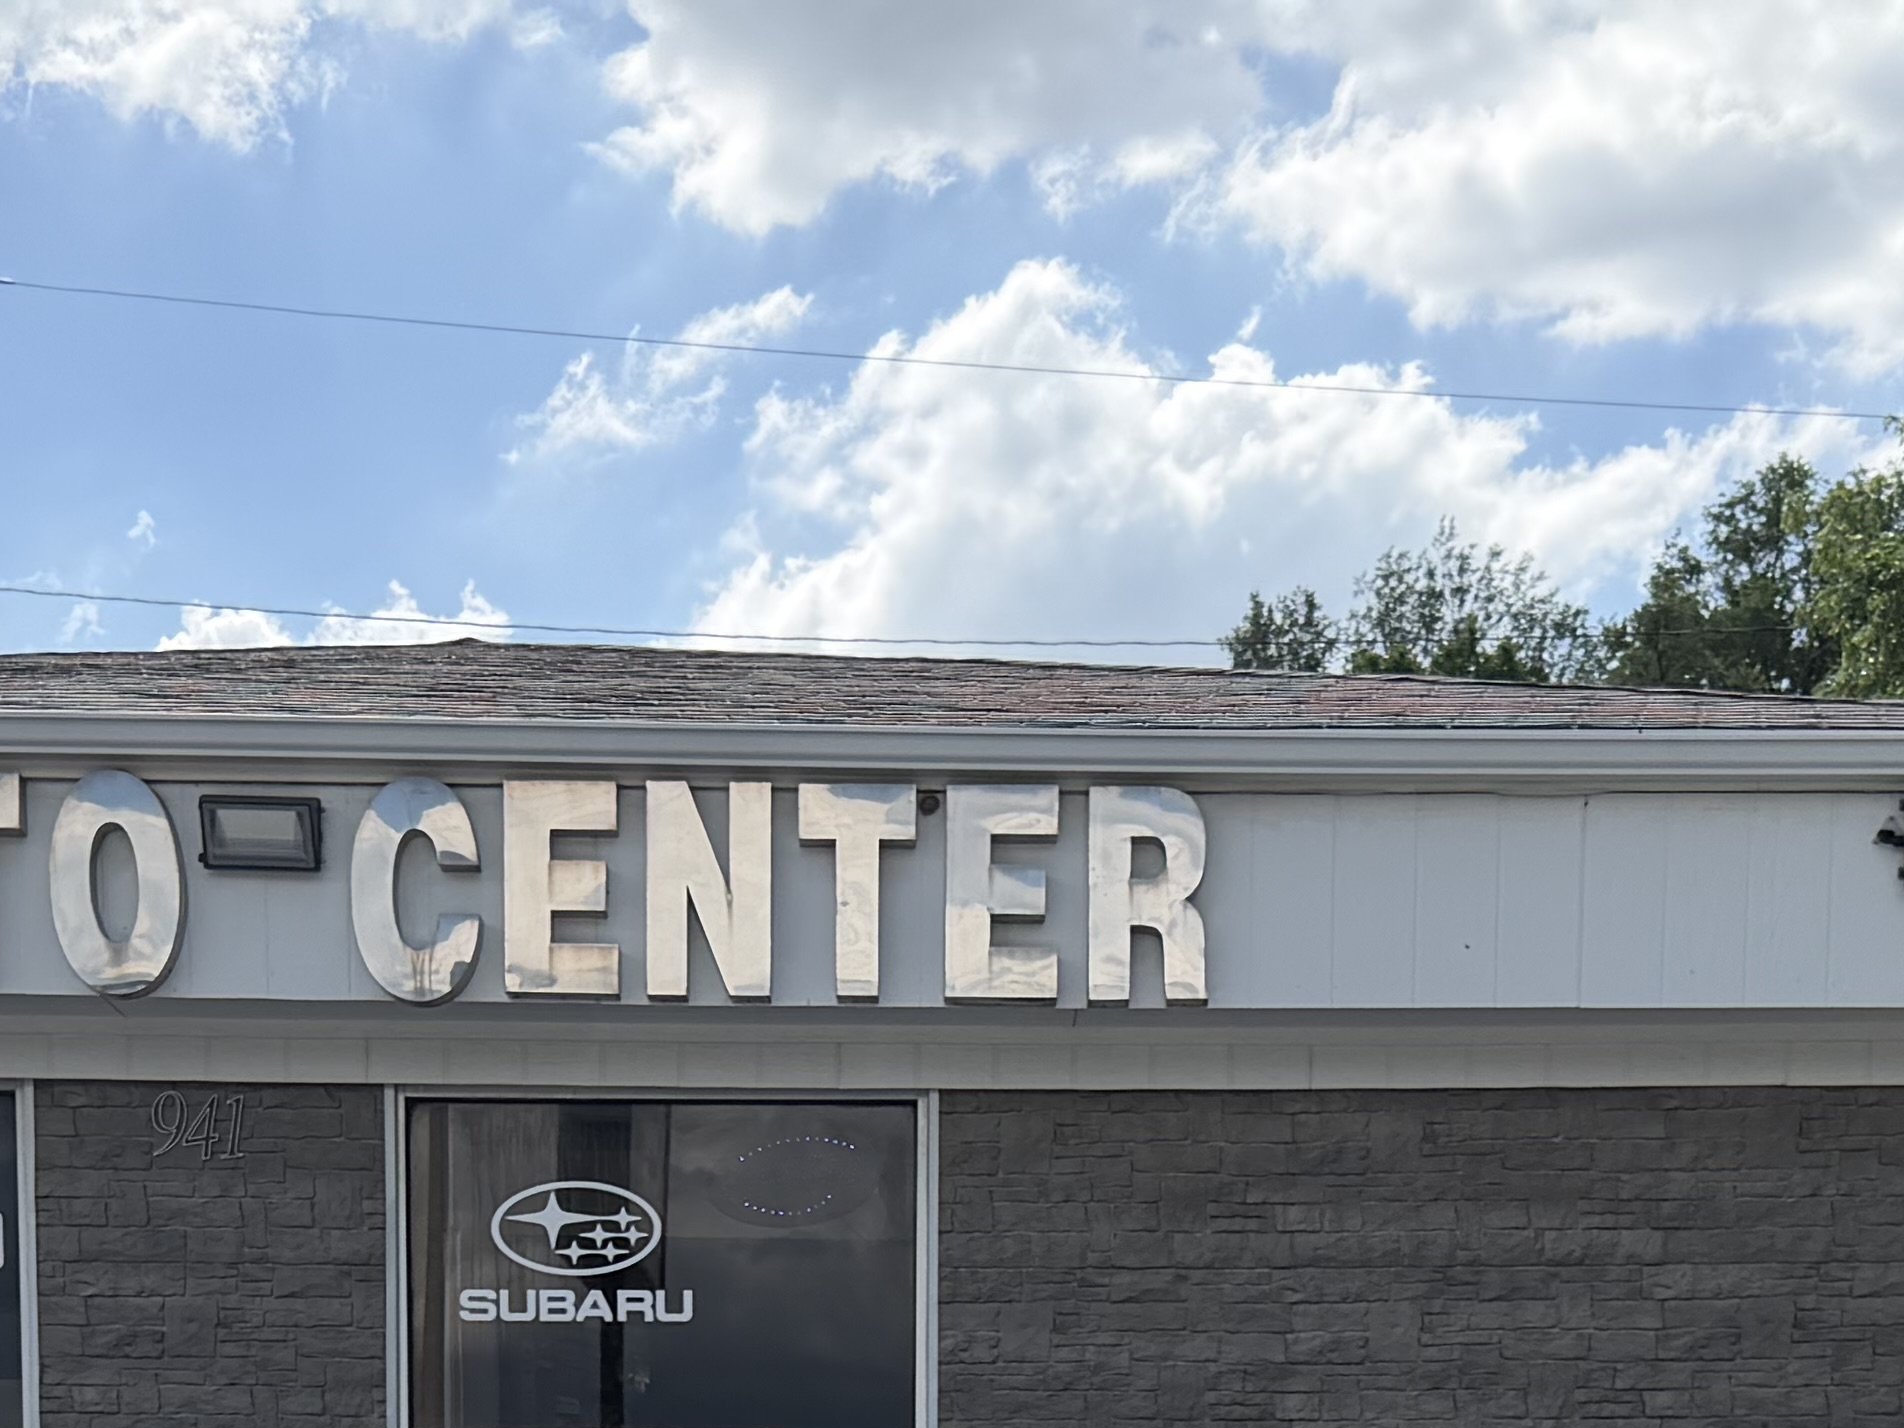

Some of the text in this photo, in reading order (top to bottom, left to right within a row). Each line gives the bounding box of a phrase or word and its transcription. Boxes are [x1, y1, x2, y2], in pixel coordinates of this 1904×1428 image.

[351, 776, 1208, 1007] CENTER
[151, 1090, 245, 1160] 941
[459, 1289, 693, 1323] SUBARU
